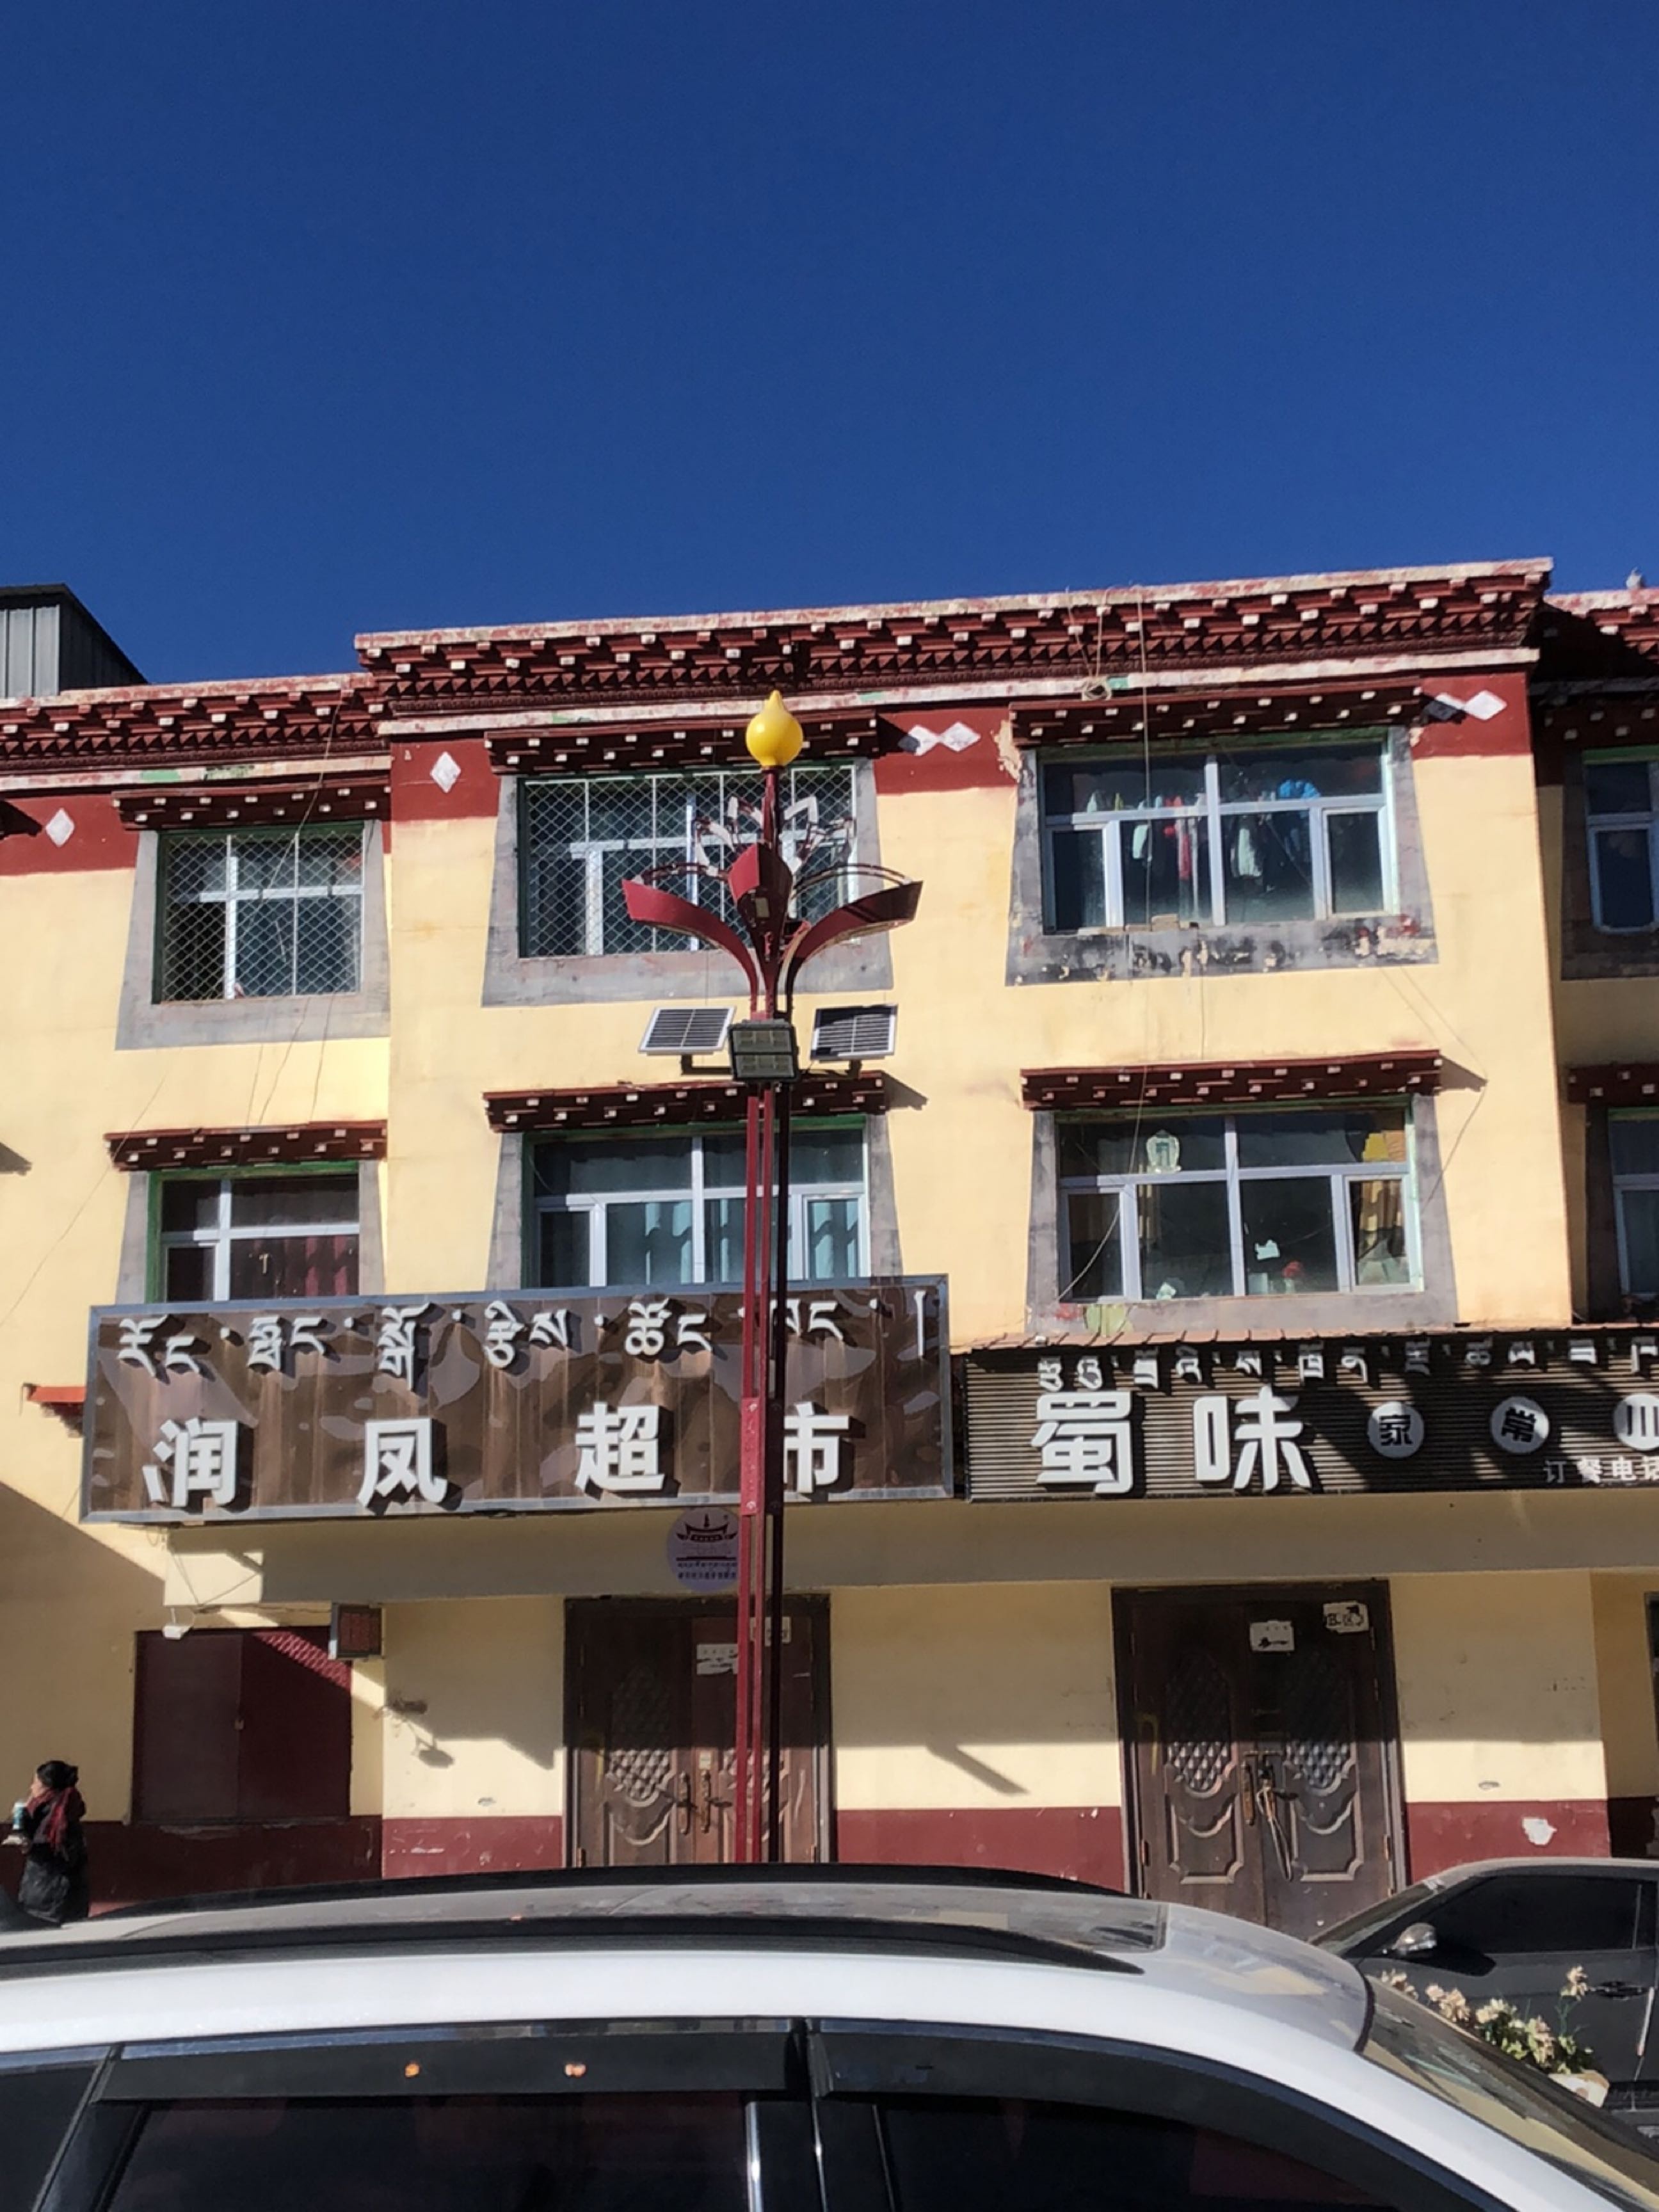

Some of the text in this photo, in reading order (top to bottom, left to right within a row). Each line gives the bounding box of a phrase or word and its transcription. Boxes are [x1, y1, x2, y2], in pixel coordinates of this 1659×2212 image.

[143, 1402, 849, 1509] 润凤超市
[1031, 1384, 1311, 1495] 蜀味
